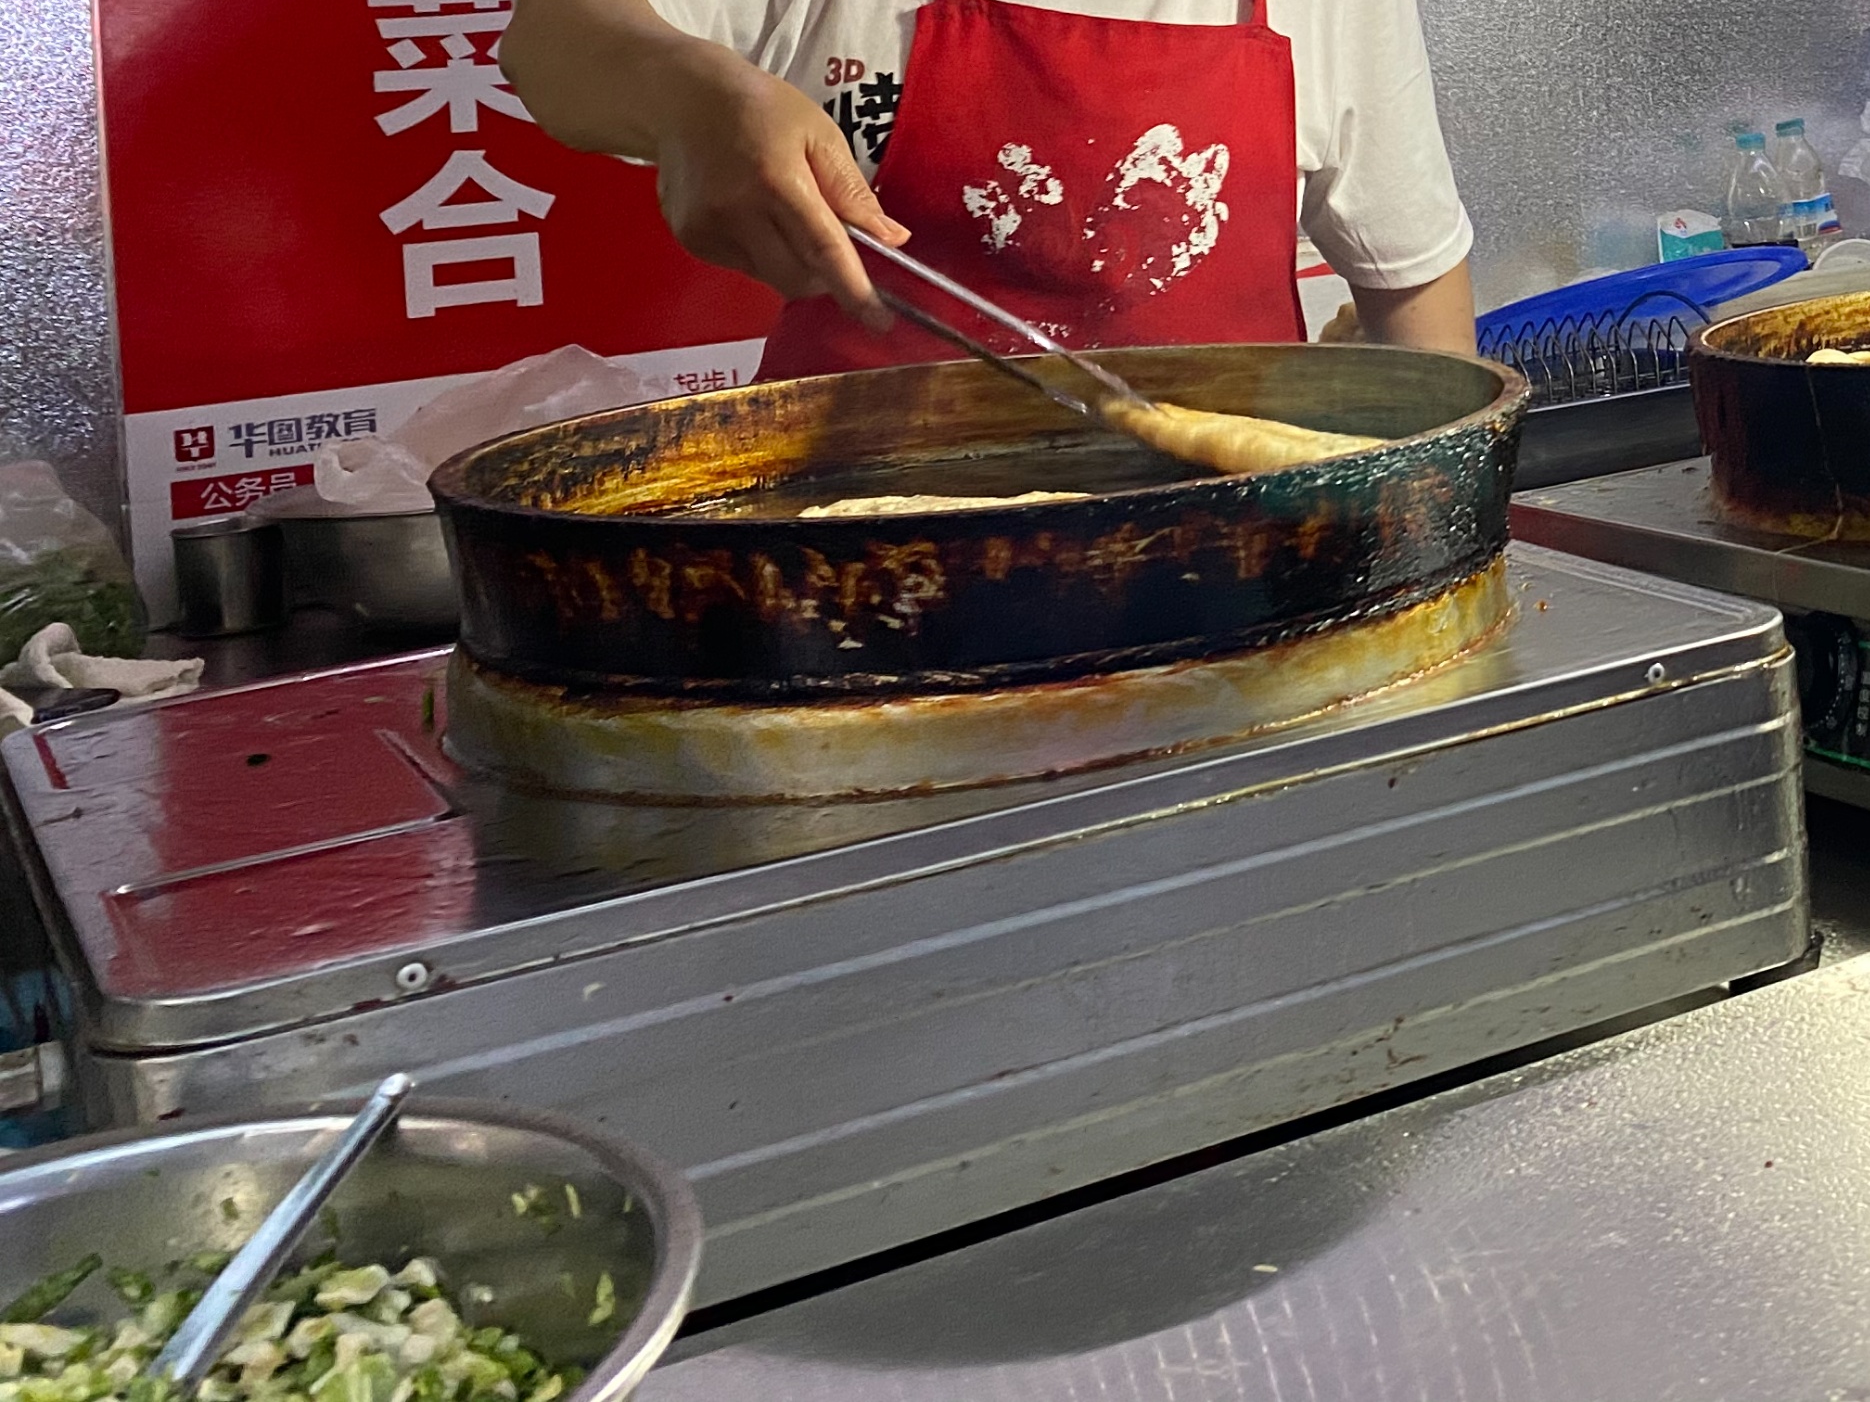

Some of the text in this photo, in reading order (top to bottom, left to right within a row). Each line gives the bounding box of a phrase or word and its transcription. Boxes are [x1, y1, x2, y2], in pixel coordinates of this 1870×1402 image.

[823, 56, 866, 87] 3D
[227, 407, 378, 459] 华图教育
